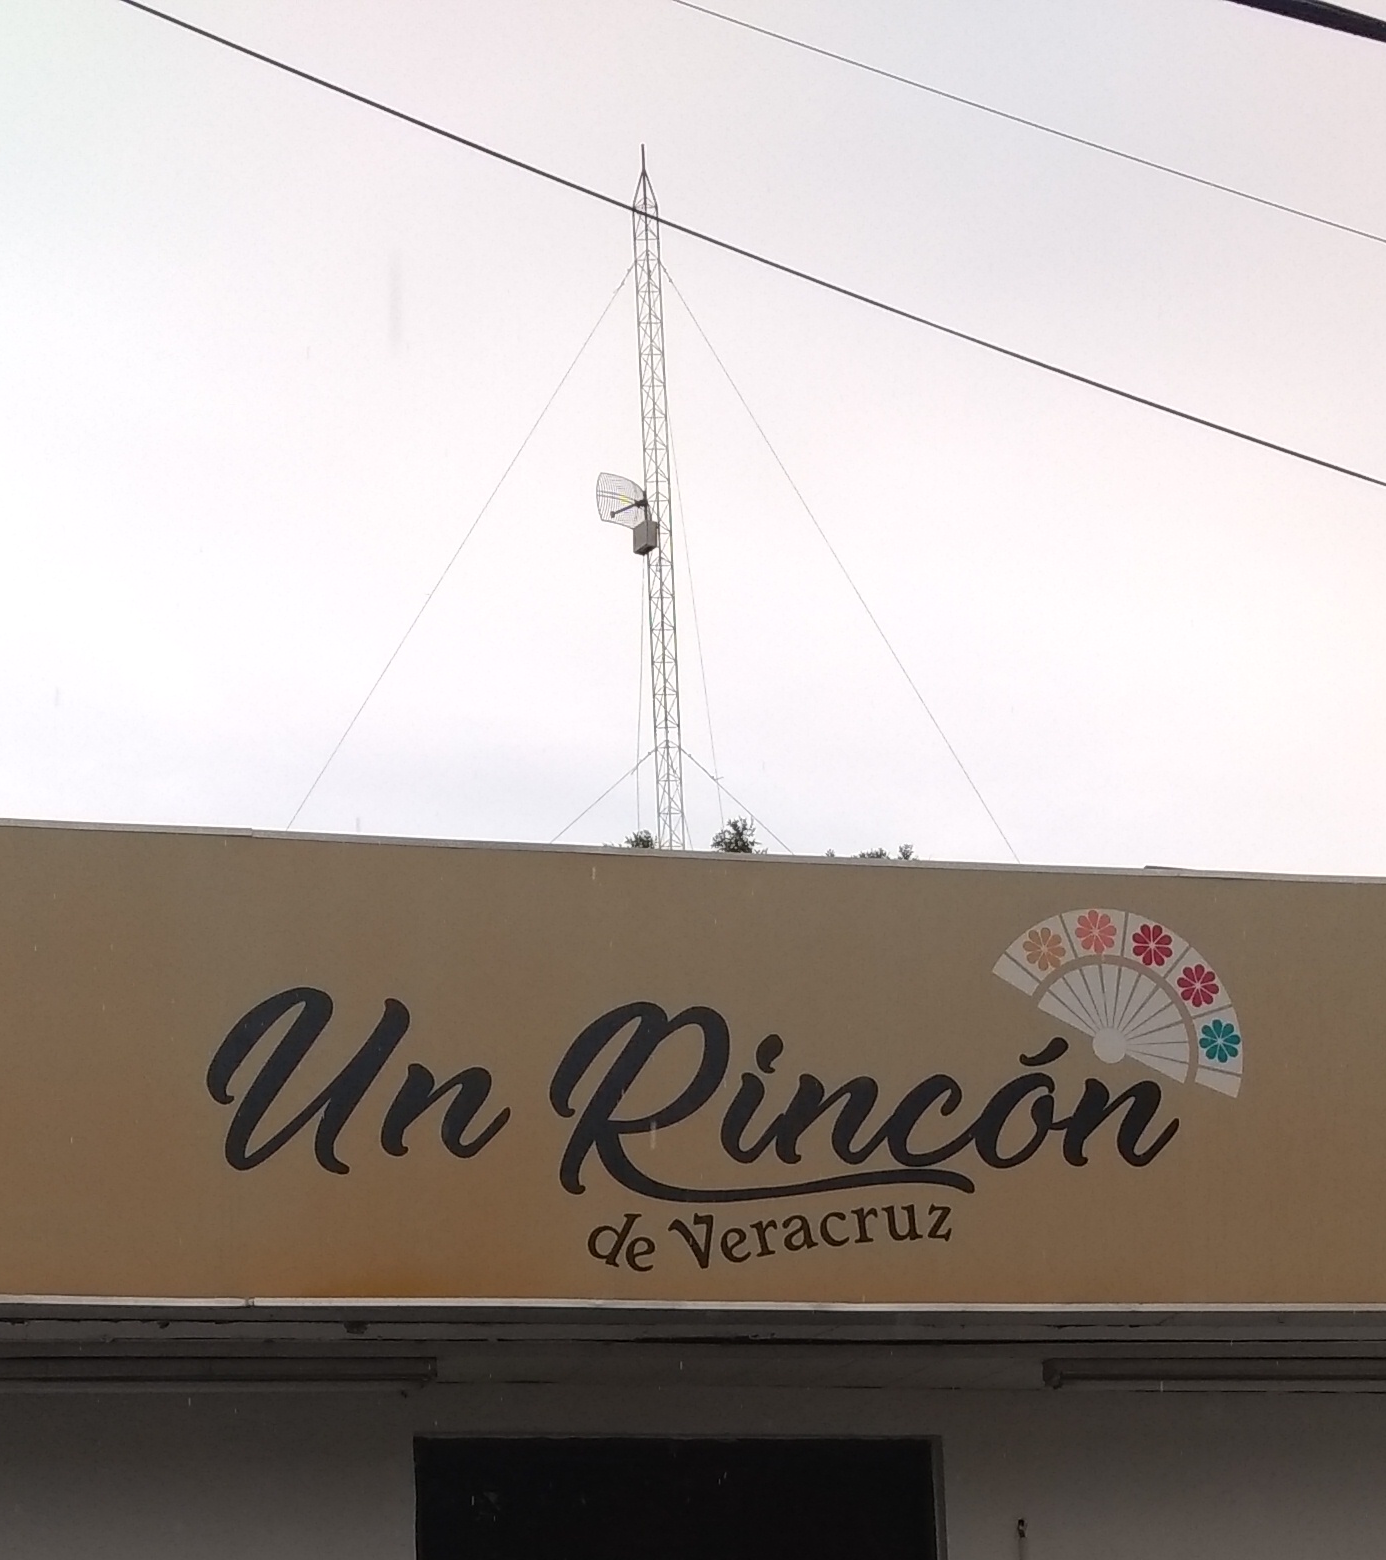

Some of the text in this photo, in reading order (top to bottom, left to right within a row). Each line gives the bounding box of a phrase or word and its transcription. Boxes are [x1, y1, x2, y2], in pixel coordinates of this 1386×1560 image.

[206, 986, 1180, 1204] Un Rincón
[587, 1203, 953, 1272] de Veracruz
